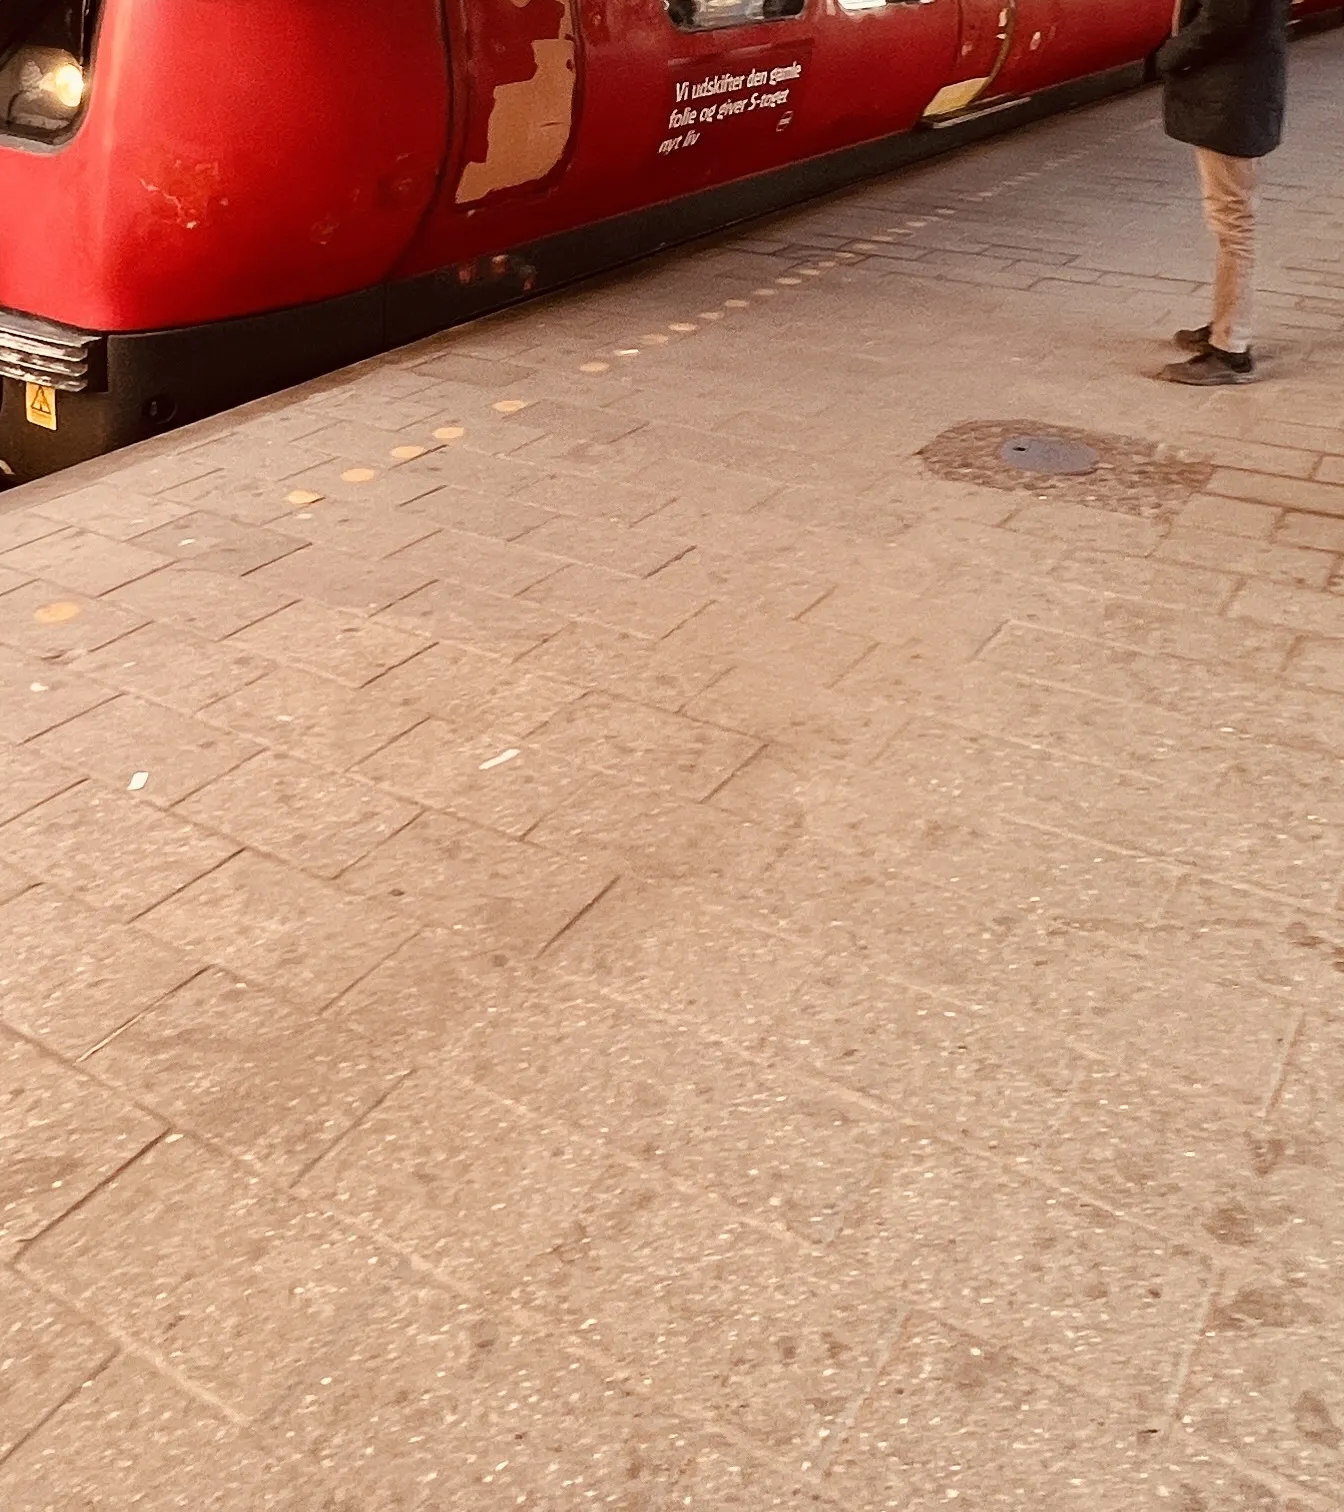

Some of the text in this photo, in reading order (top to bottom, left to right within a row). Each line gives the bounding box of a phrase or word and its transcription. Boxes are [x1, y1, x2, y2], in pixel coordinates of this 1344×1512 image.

[675, 81, 689, 102] Vi
[746, 68, 767, 88] den
[668, 106, 697, 129] folie
[699, 103, 717, 122] og
